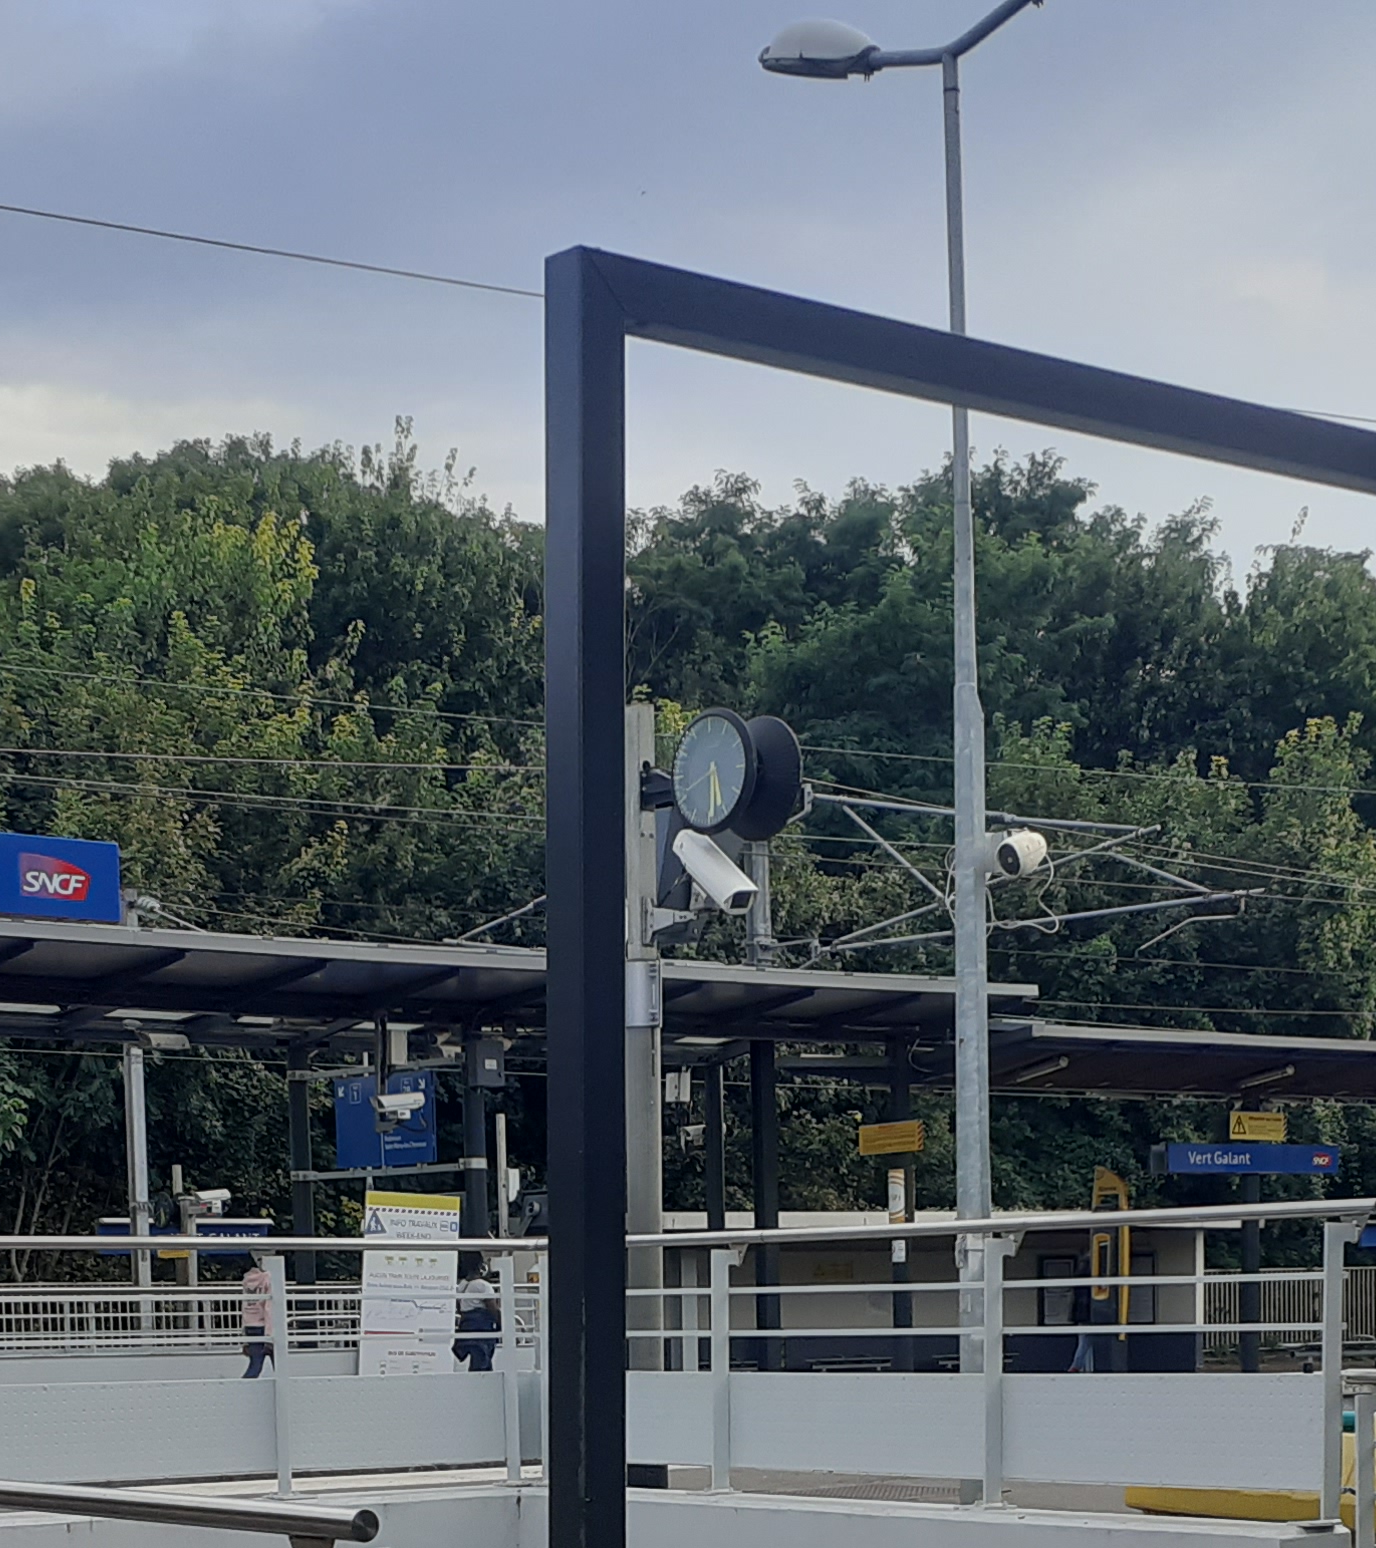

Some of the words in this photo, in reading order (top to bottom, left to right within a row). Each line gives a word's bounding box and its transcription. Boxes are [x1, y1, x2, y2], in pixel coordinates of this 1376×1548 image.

[22, 870, 87, 896] SNCF
[1188, 1151, 1212, 1165] Vert
[1213, 1151, 1251, 1165] Galant
